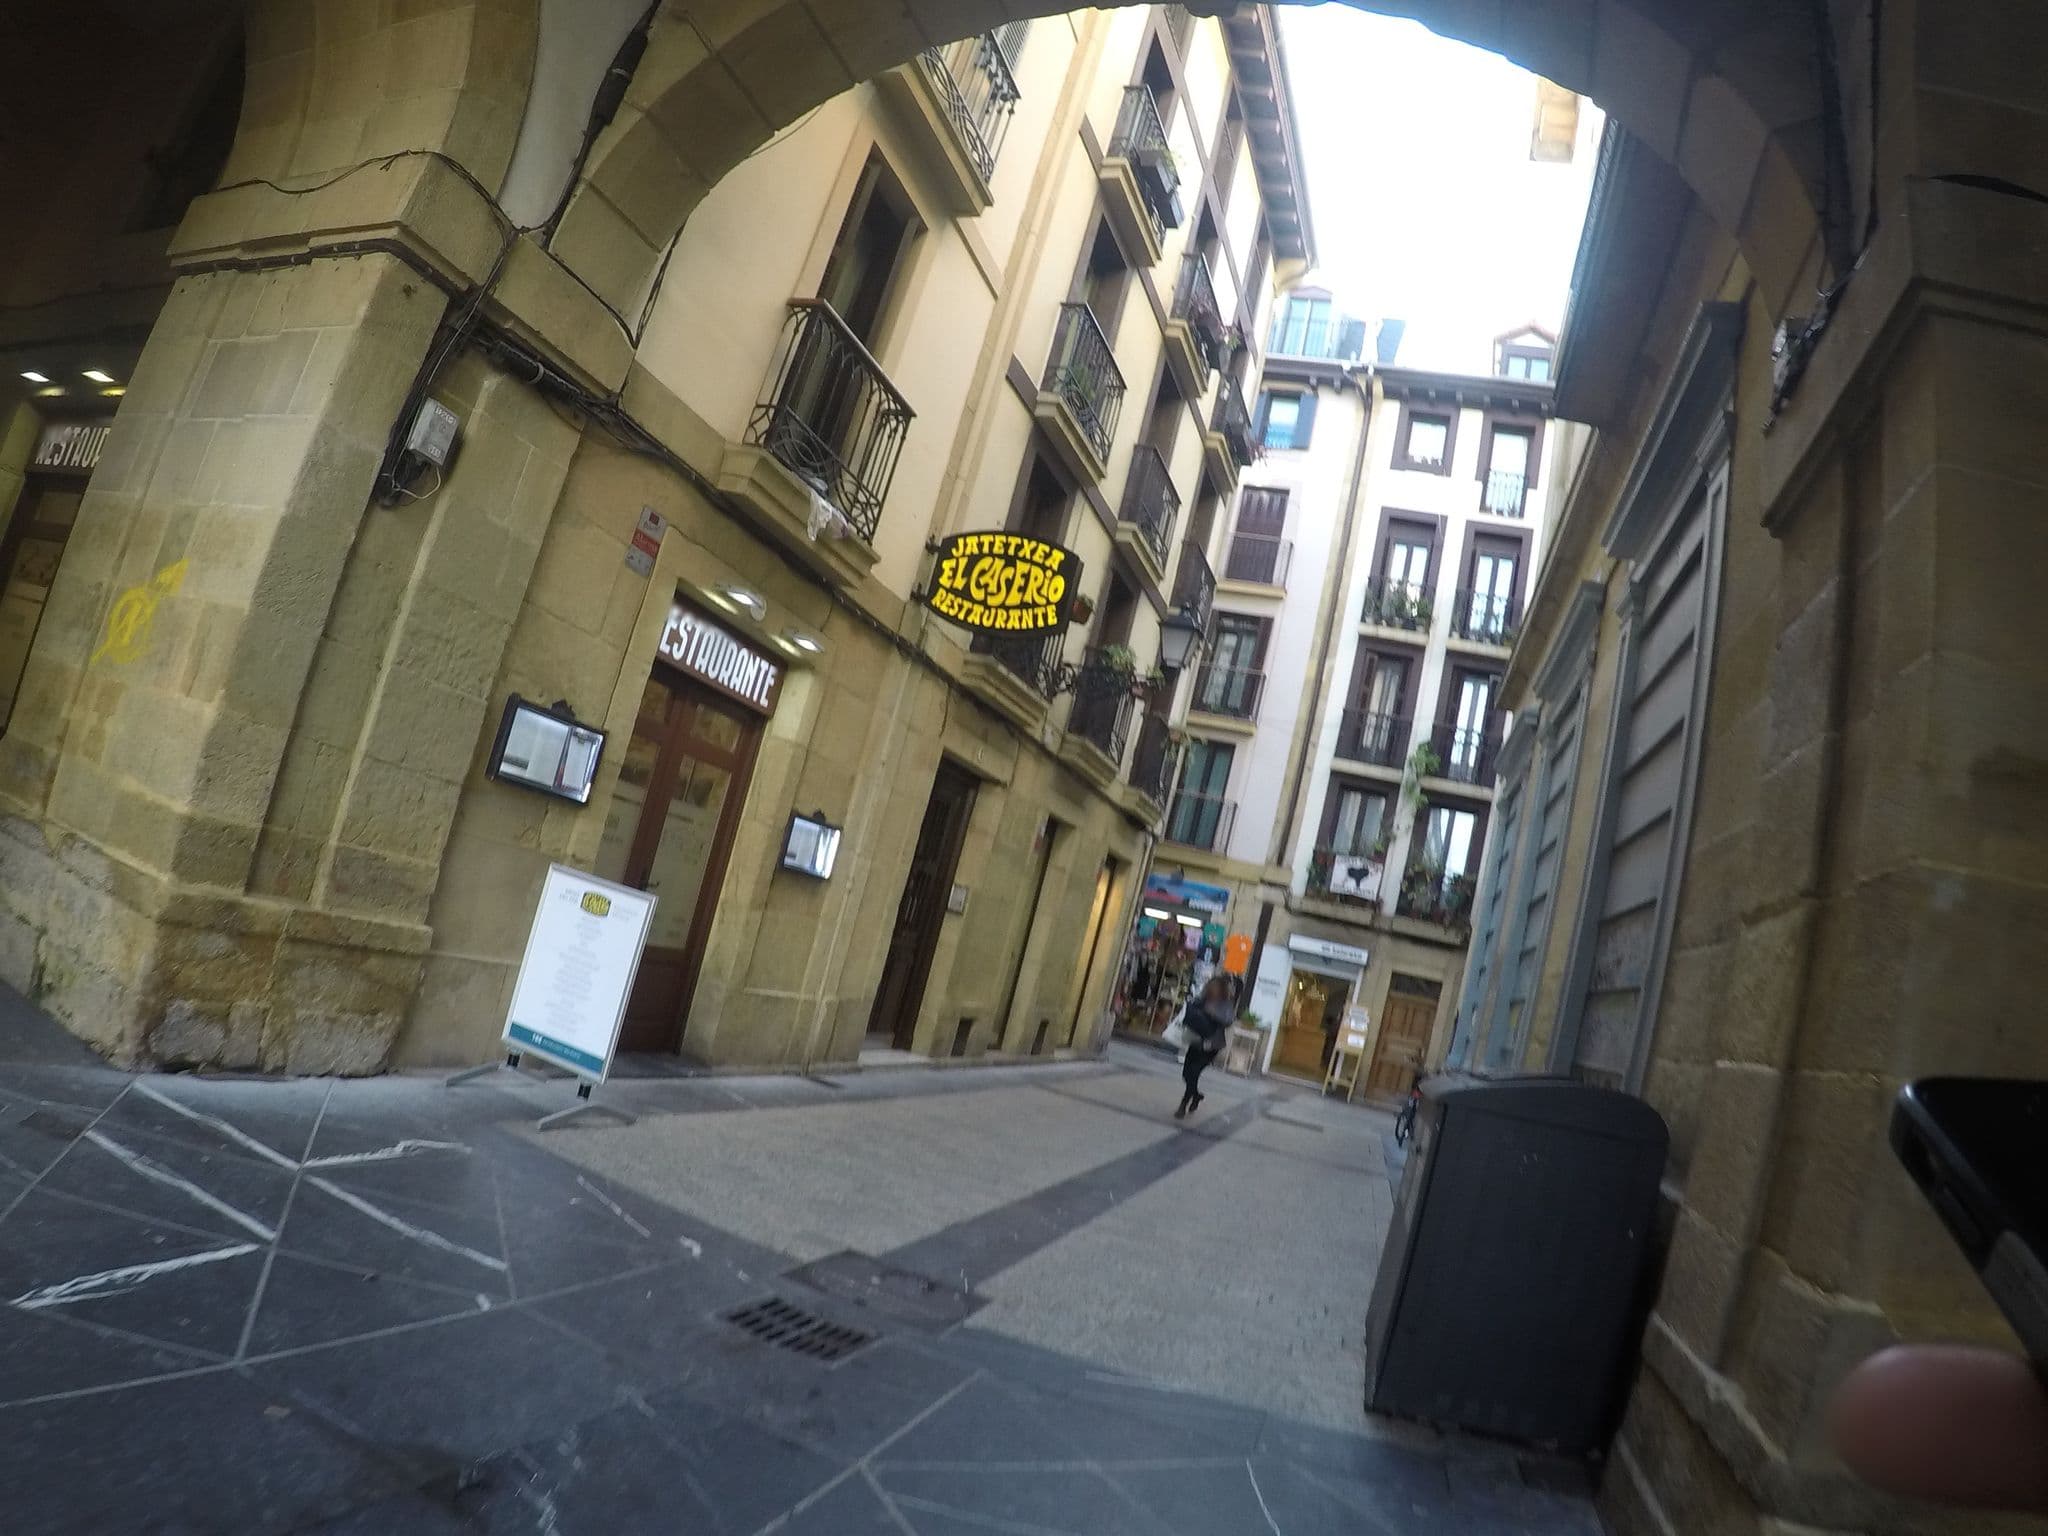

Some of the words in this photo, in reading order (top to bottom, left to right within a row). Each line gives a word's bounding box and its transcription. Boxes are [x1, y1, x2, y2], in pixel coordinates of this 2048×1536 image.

[951, 534, 1065, 572] JATETXEA
[939, 556, 968, 591] EL
[931, 587, 1058, 630] RESTAURANTE
